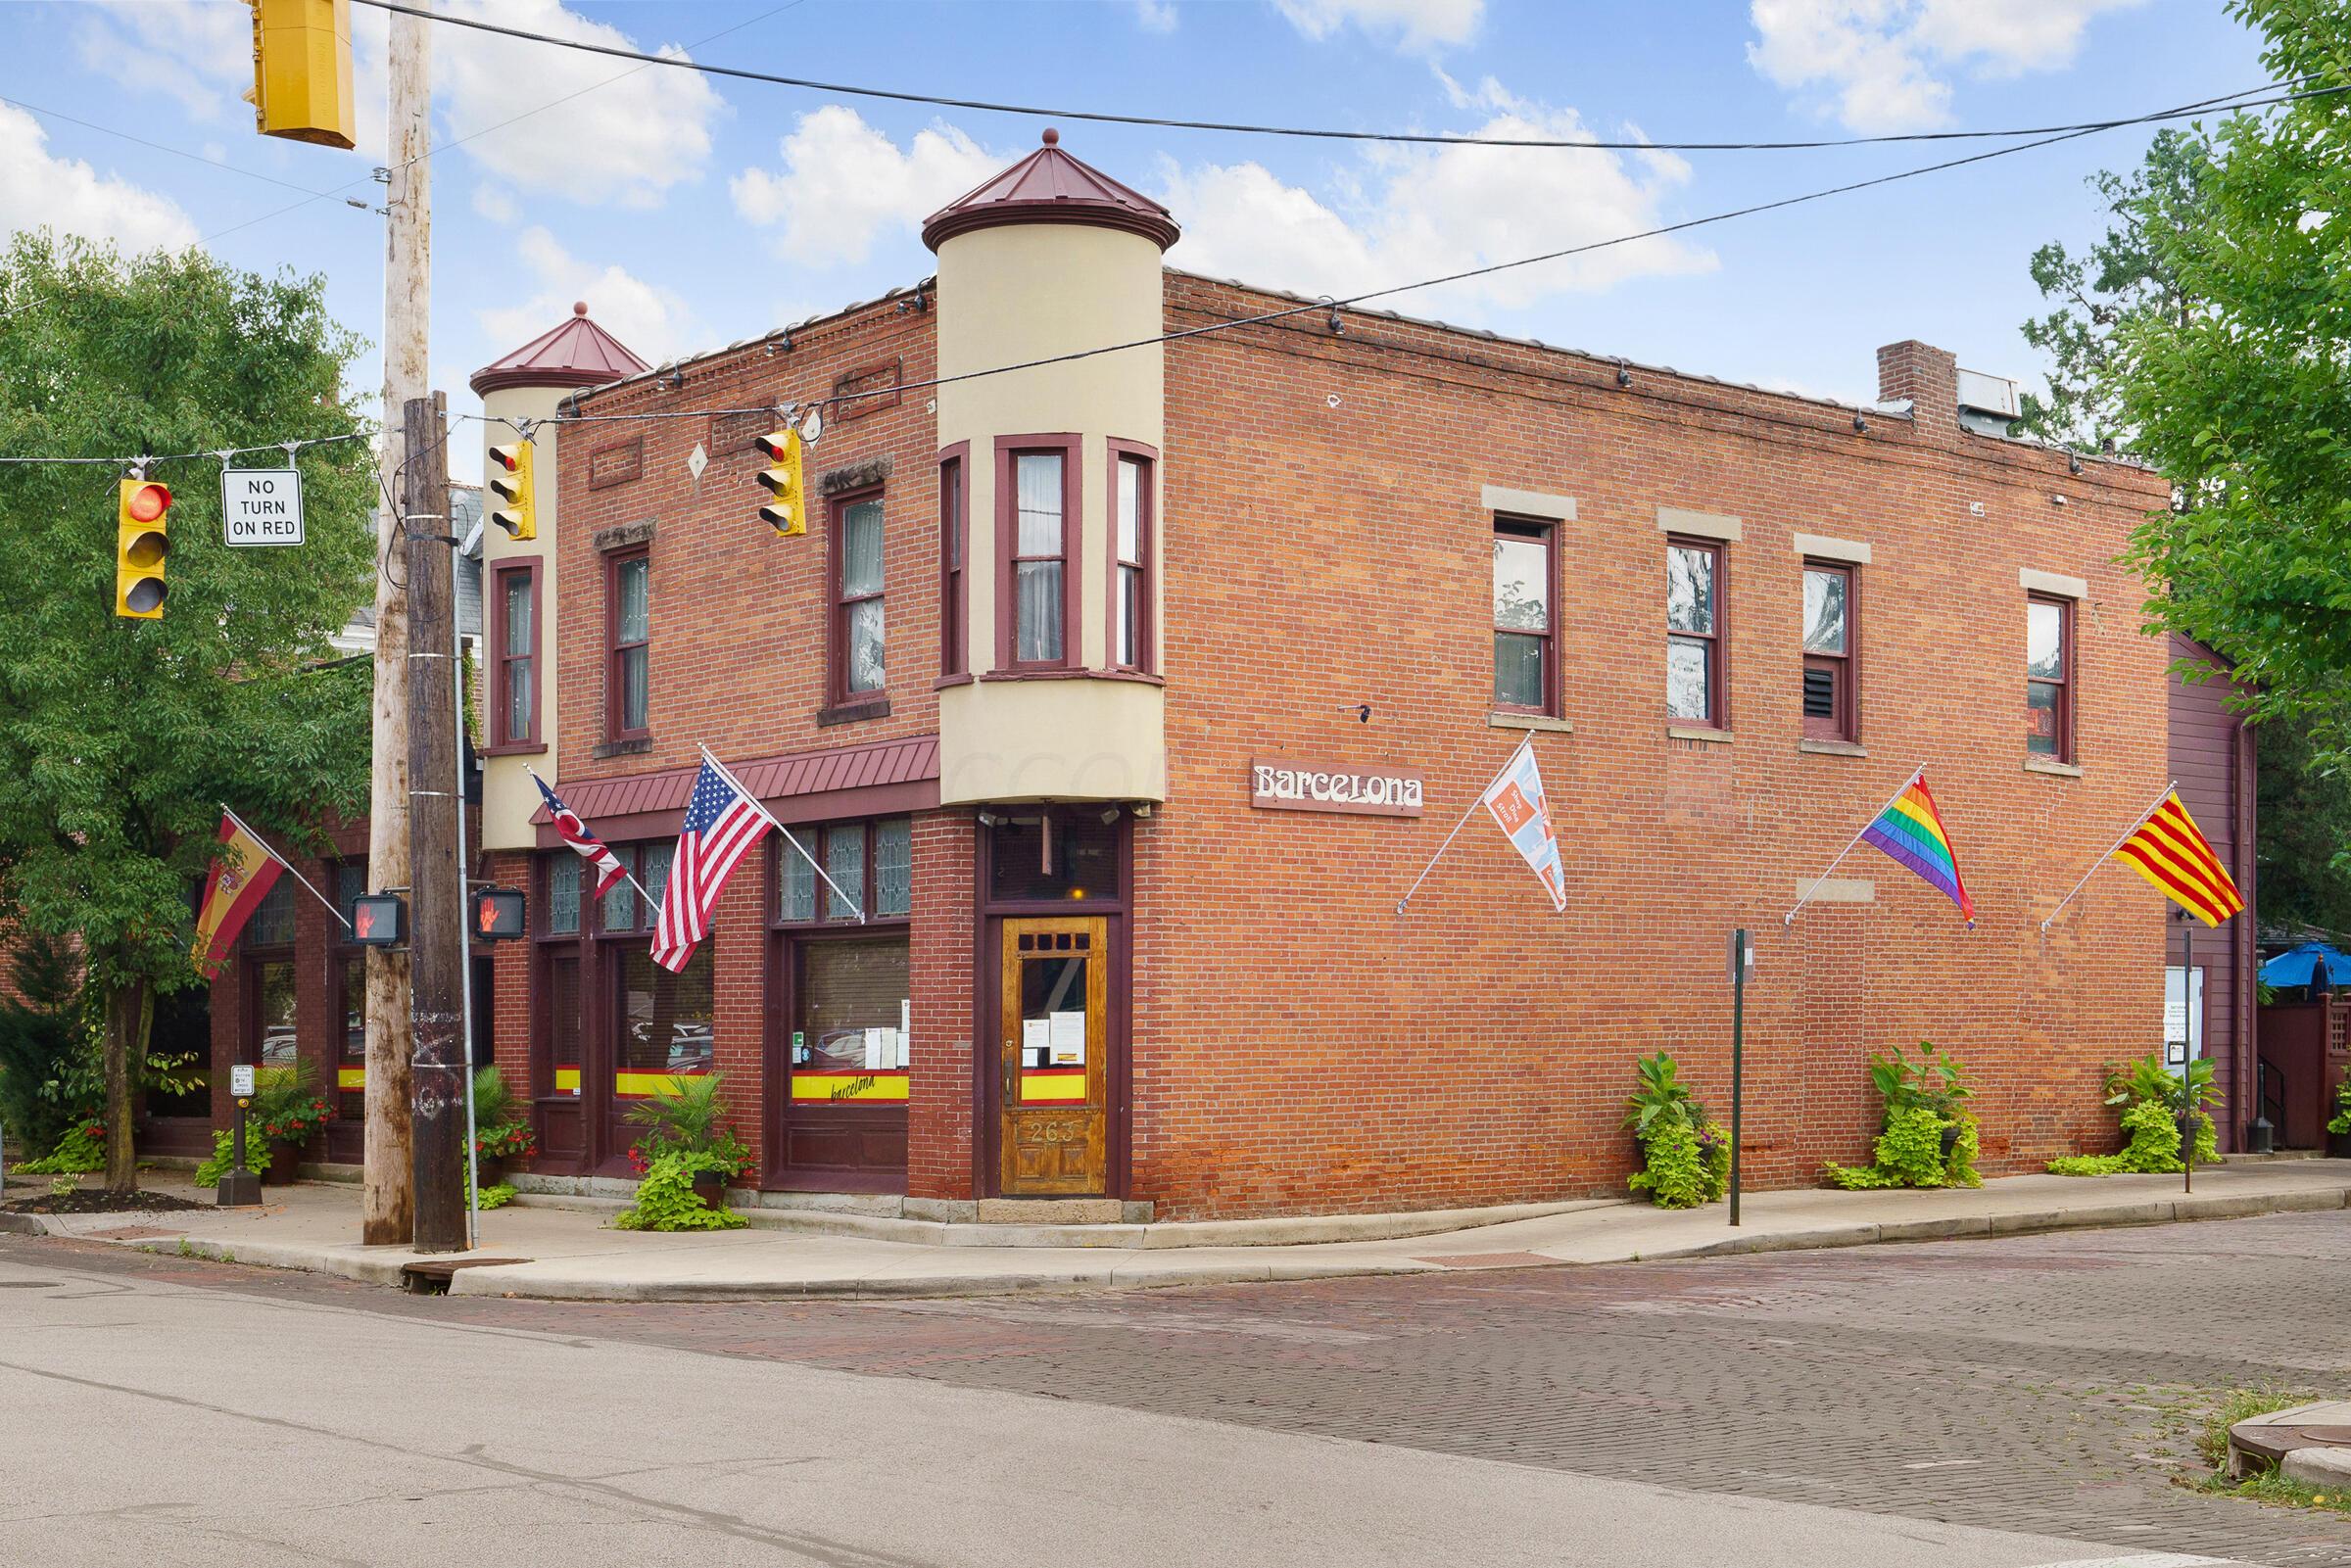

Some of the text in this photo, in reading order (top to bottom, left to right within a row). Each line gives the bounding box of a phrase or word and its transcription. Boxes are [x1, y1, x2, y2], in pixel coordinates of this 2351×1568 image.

[248, 480, 274, 494] NO
[240, 500, 285, 514] TURN
[233, 521, 295, 535] ON RED
[1511, 789, 1522, 810] Shop
[1496, 802, 1512, 824] Stroll
[1509, 803, 1519, 824] Dine
[831, 1074, 875, 1102] barcelona
[1031, 1121, 1074, 1143] 263
